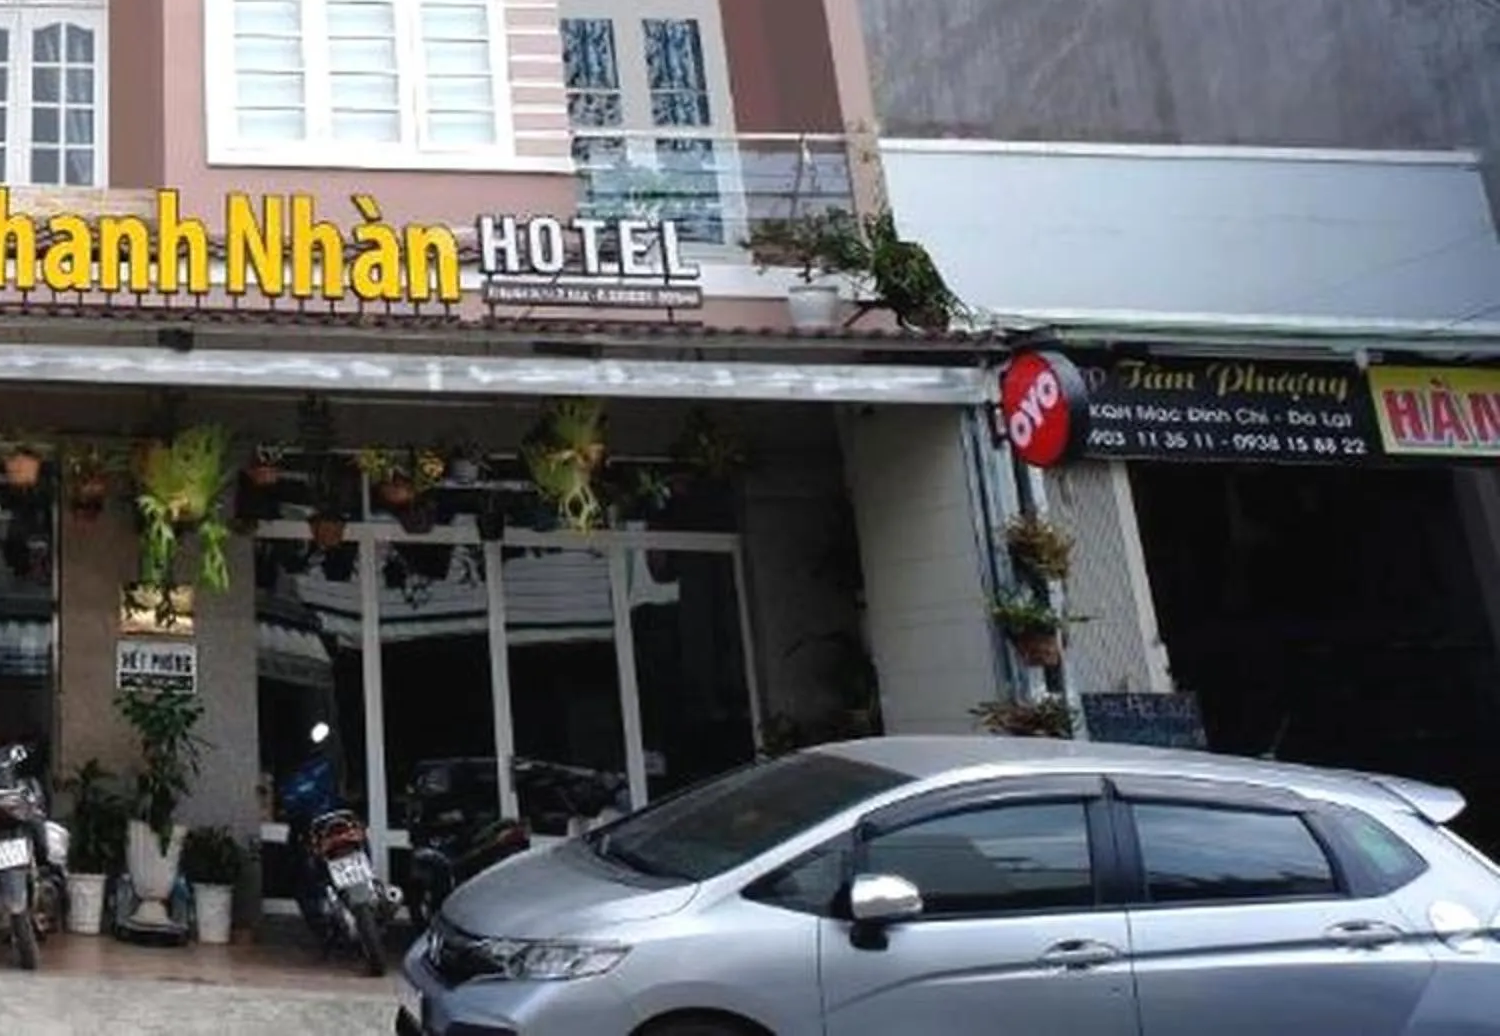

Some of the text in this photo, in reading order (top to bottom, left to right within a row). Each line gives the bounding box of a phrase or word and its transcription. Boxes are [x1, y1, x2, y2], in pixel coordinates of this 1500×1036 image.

[225, 189, 462, 302] Nhàn
[479, 214, 700, 277] HOTEL
[1009, 370, 1059, 449] OYO
